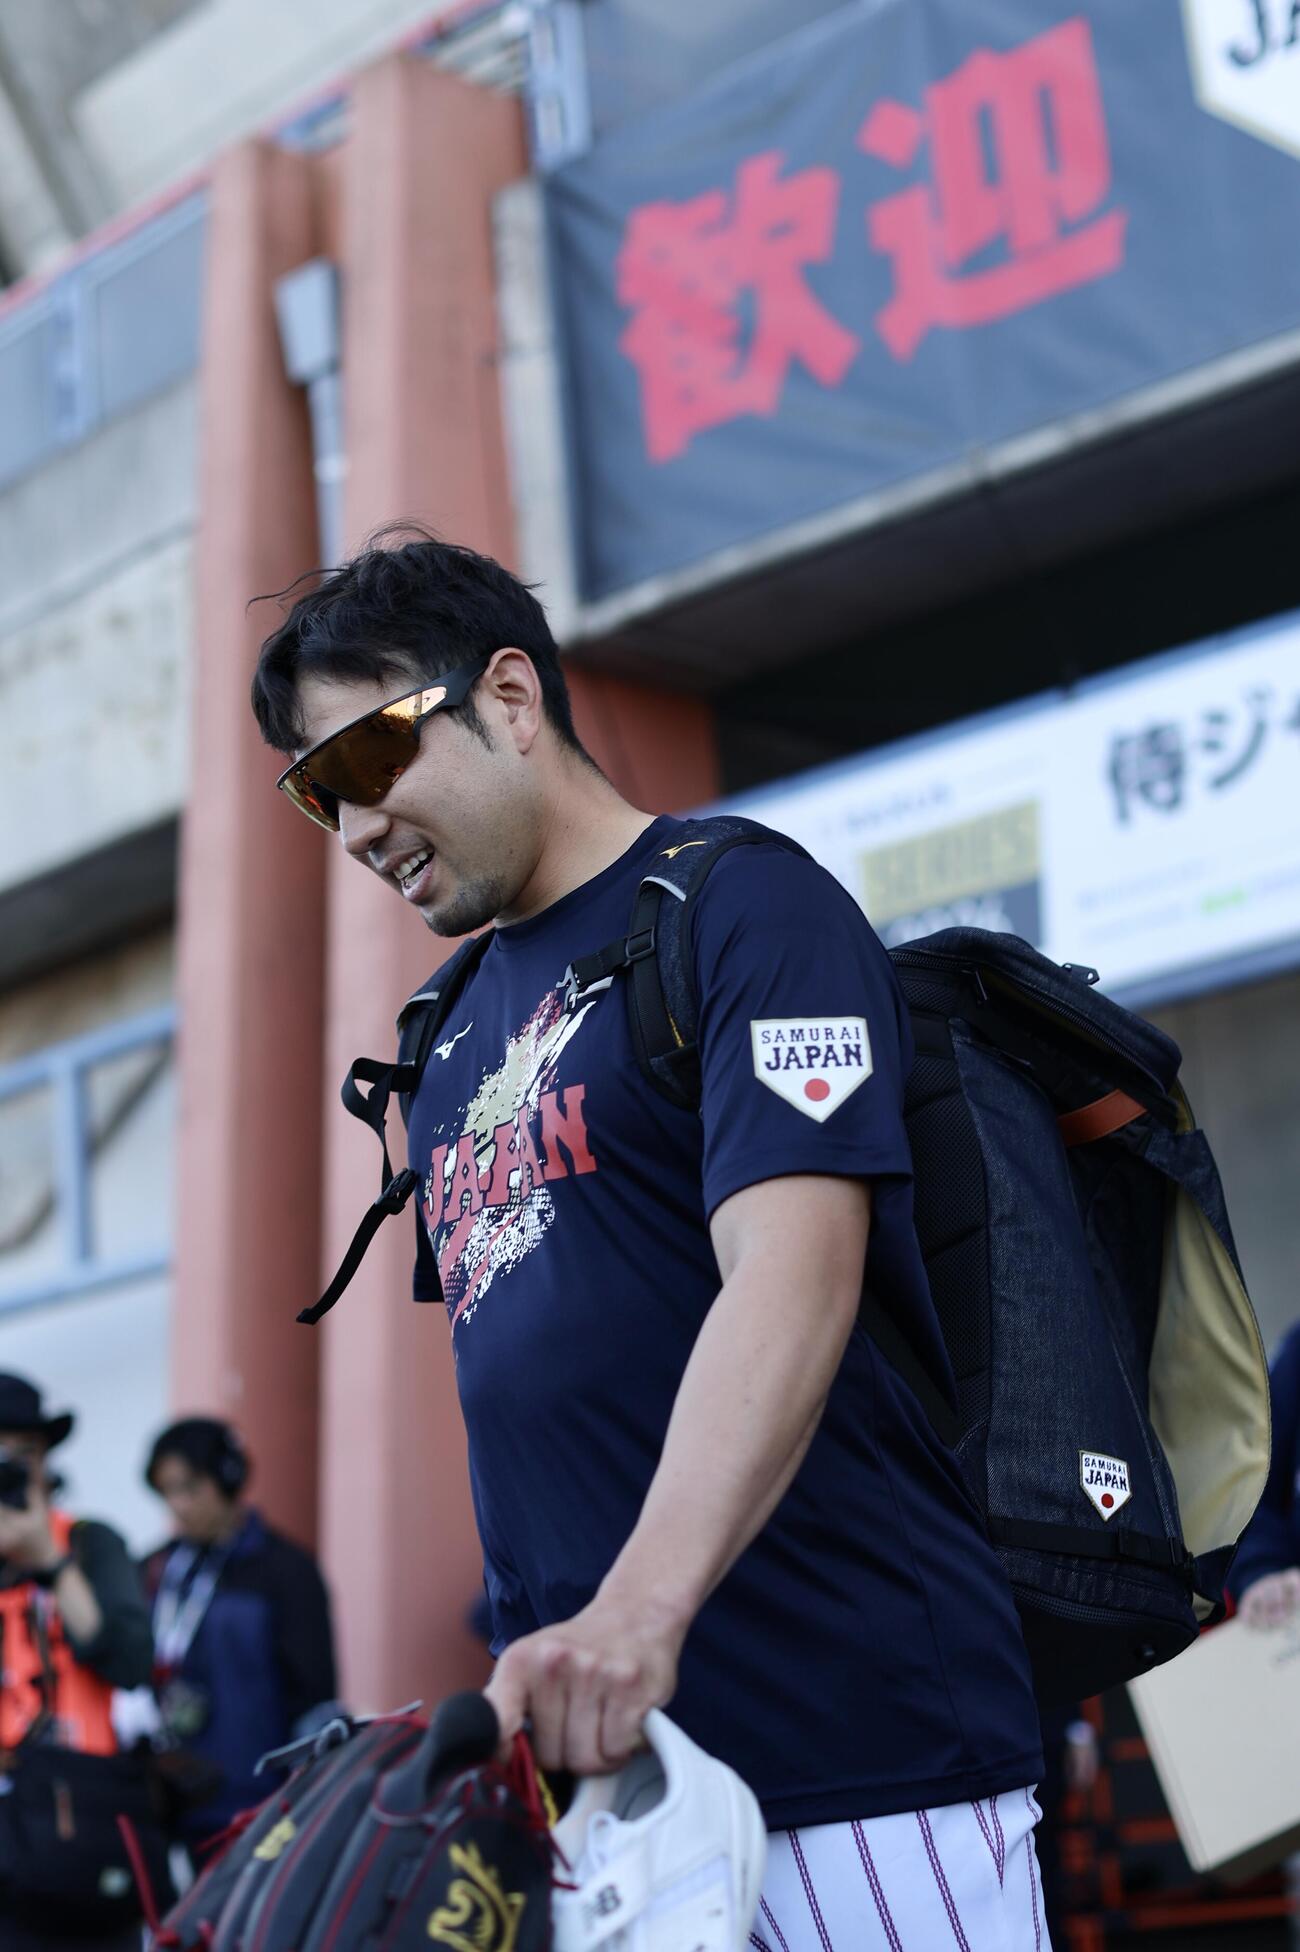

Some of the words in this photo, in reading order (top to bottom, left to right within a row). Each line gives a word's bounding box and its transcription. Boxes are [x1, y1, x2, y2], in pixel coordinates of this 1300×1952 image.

[616, 16, 1127, 464] 歓迎
[761, 1026, 861, 1045] SAMURAI
[764, 1044, 863, 1071] JAPAN
[422, 1083, 598, 1231] JAPAN
[1084, 1457, 1127, 1474] SAMURAI
[1085, 1469, 1128, 1492] JAPAN
